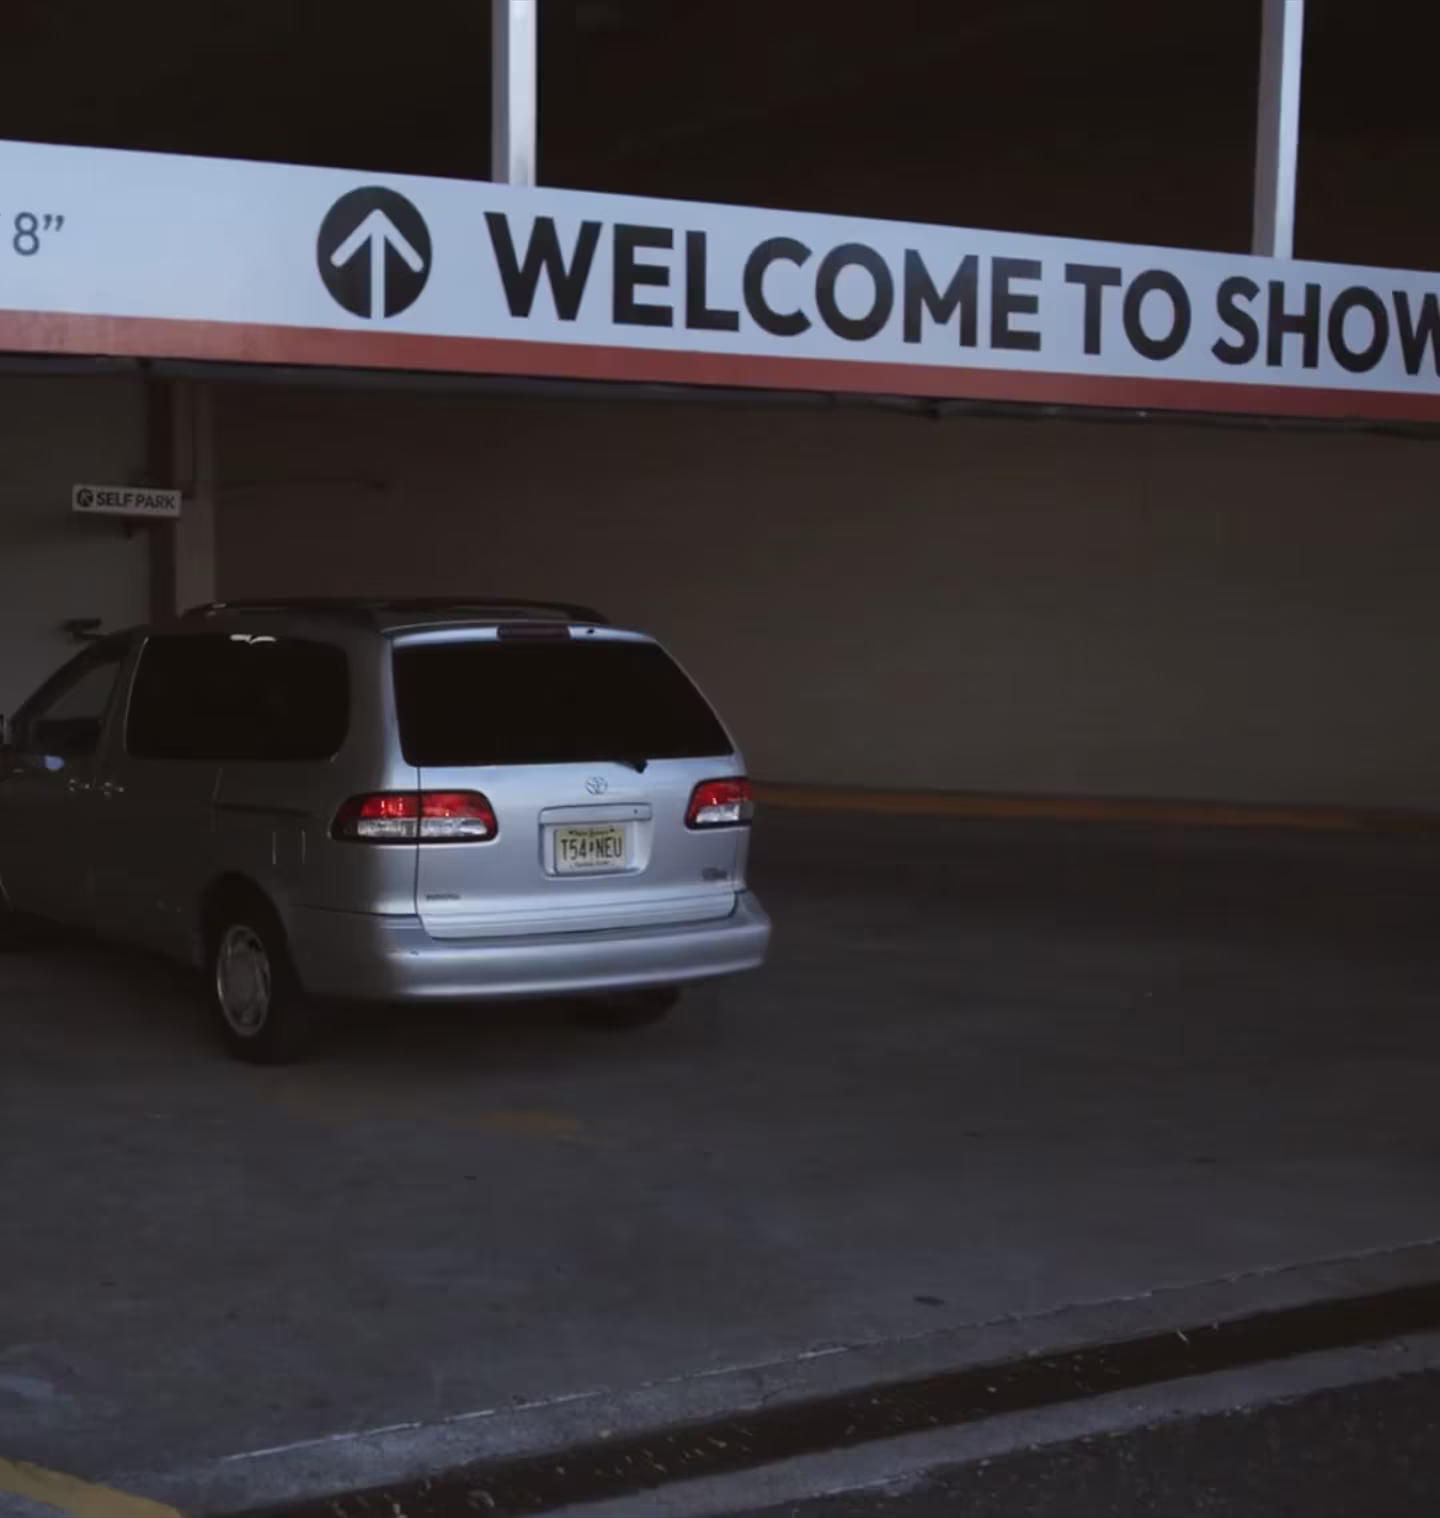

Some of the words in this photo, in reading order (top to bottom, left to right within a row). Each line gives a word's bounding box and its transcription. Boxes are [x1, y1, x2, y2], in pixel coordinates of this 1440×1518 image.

[483, 211, 1043, 352] WELCOME
[1064, 262, 1192, 362] TO
[1210, 275, 1440, 379] SHOW
[97, 492, 132, 507] SELF
[135, 494, 176, 509] PARK
